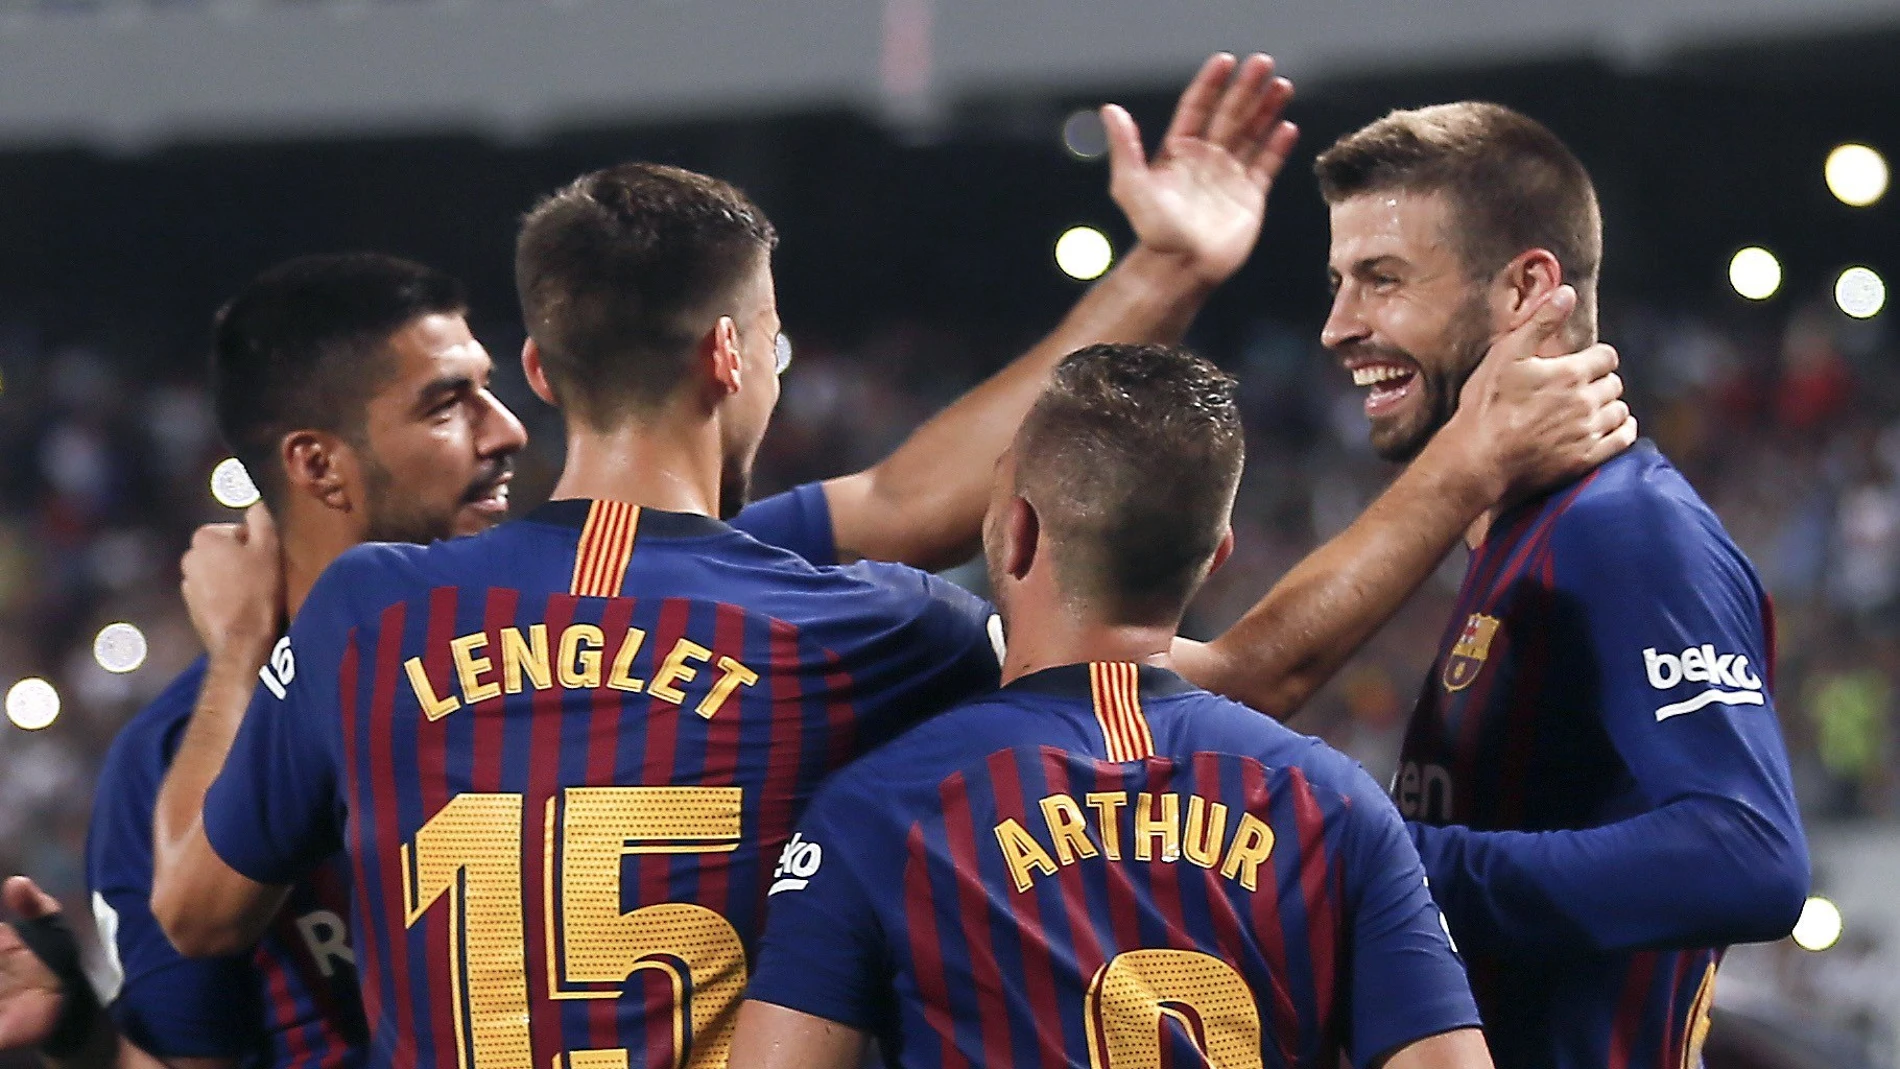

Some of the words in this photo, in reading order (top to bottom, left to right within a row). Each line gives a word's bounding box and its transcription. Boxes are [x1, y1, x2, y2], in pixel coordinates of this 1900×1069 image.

[404, 623, 759, 722] LENGLET
[1642, 643, 1763, 690] beko
[993, 791, 1275, 893] ARTHUR
[401, 786, 748, 1069] 15
